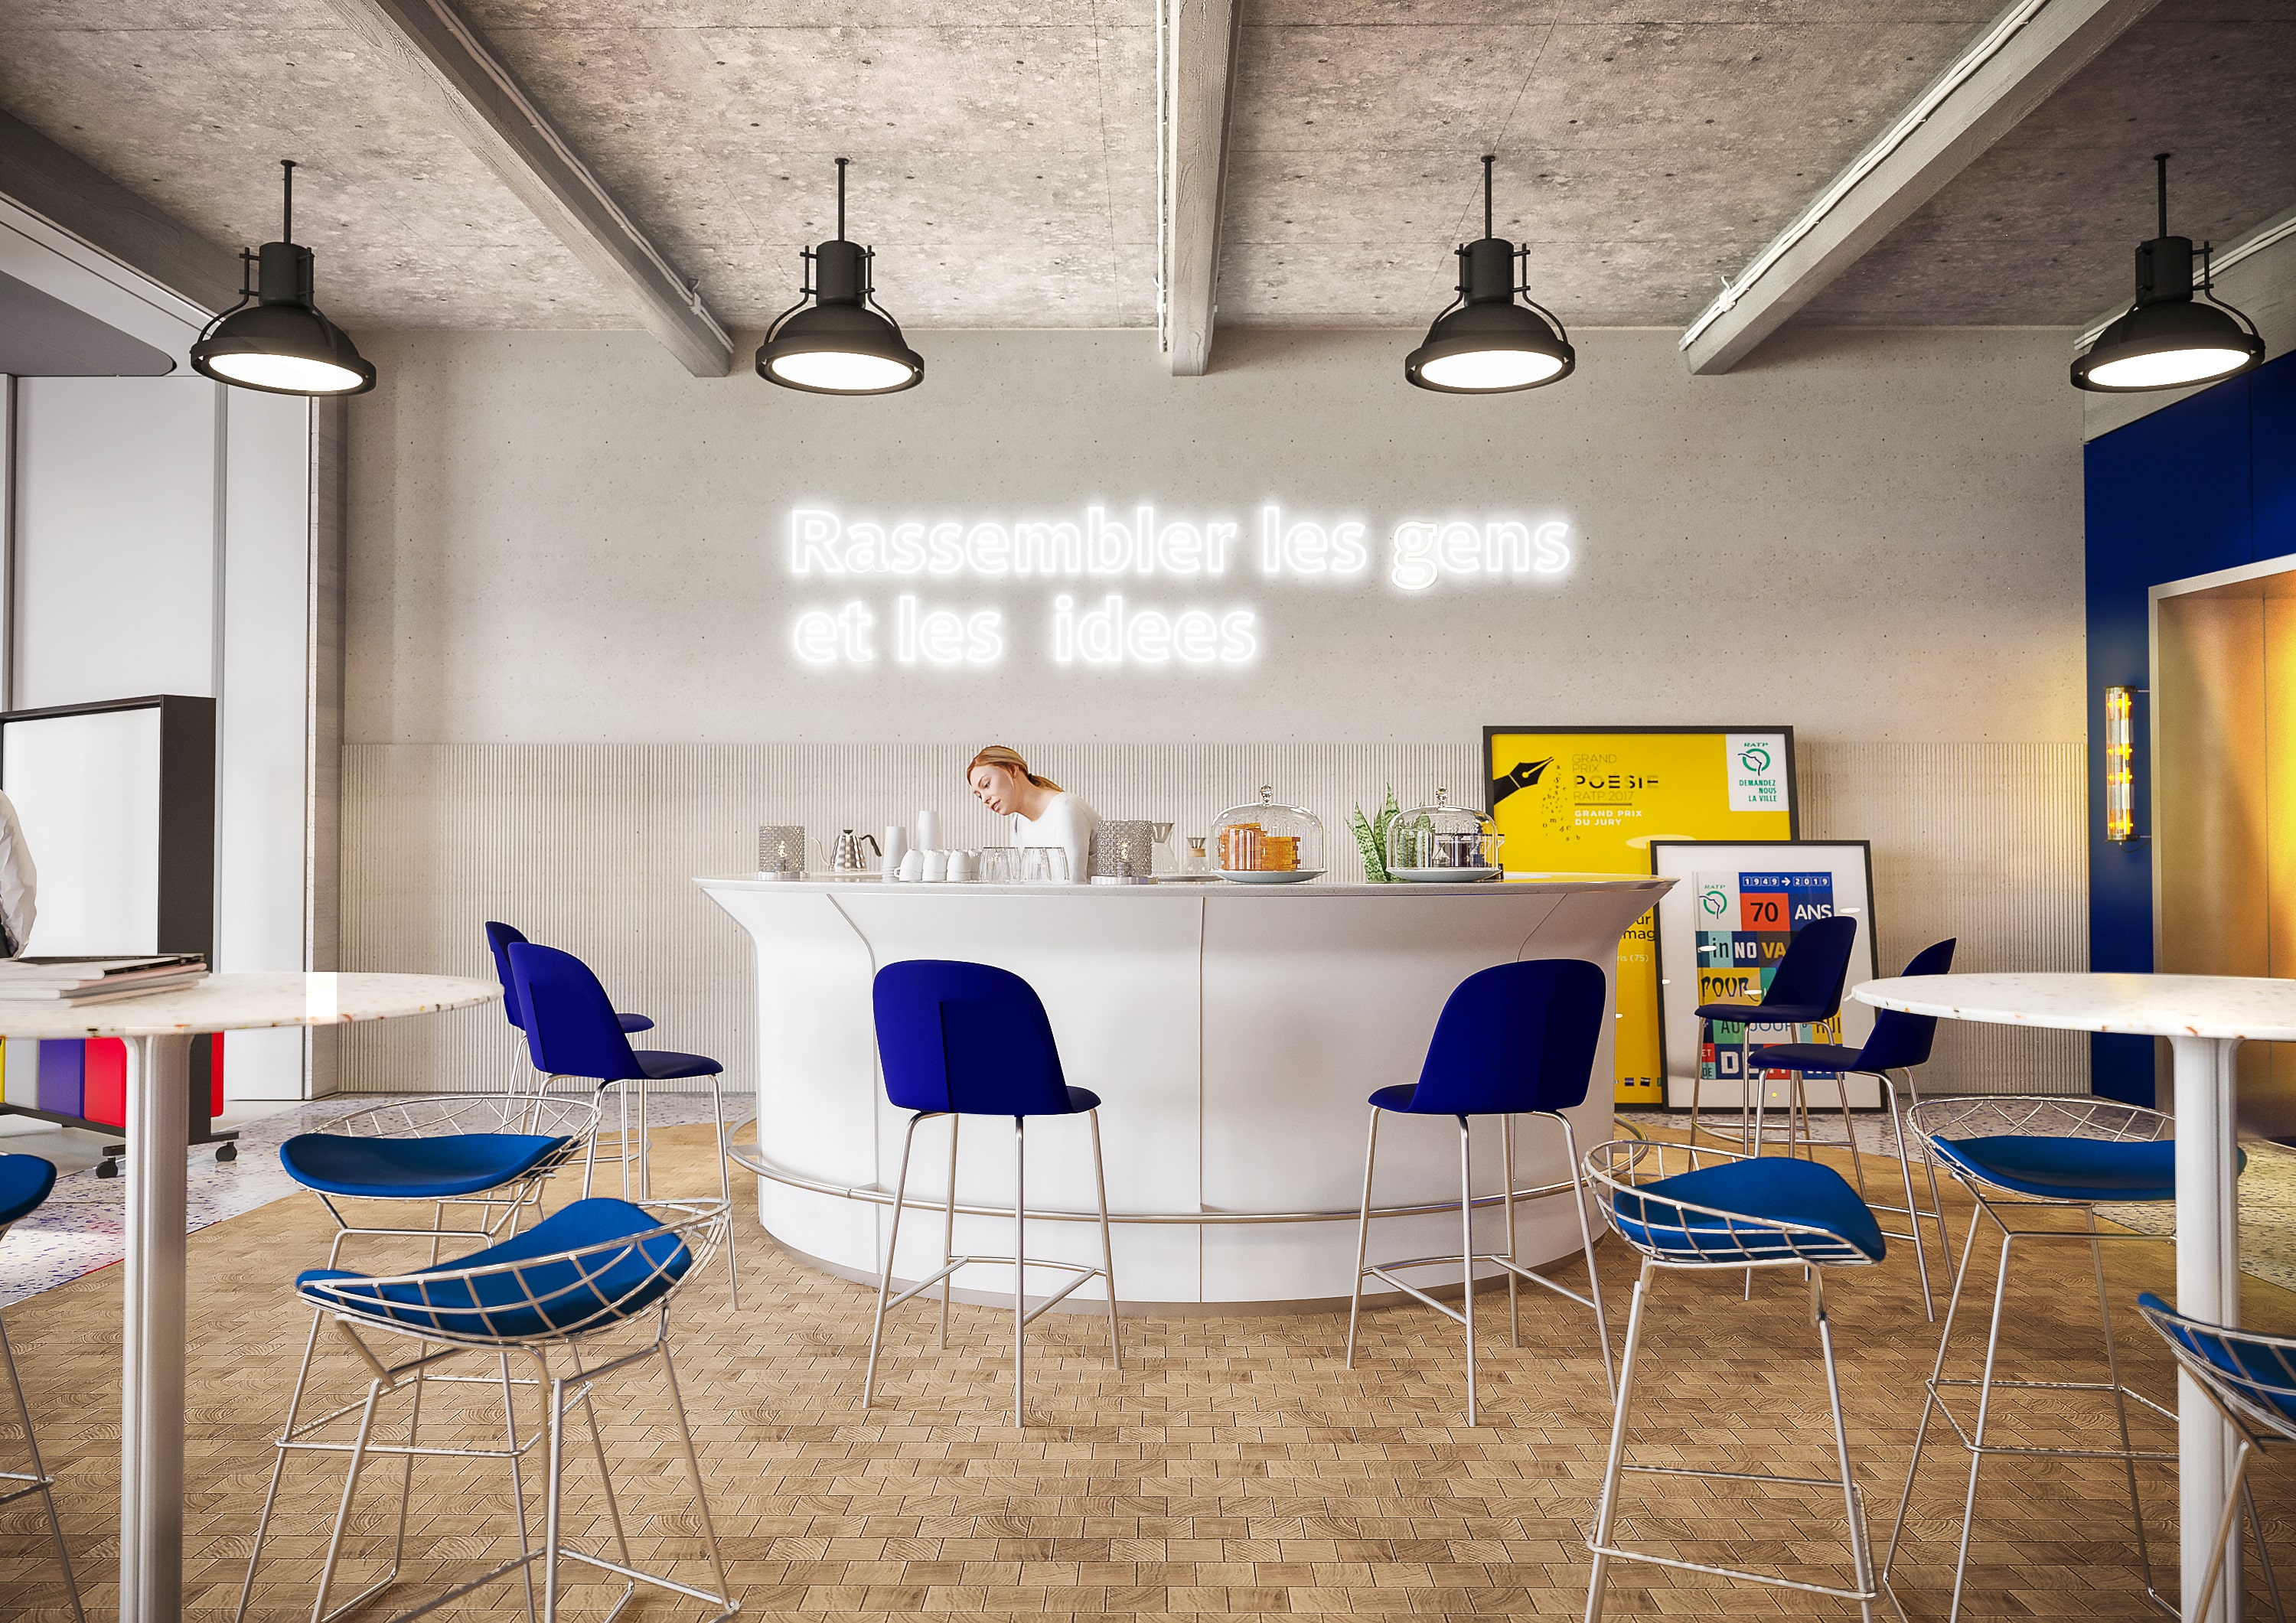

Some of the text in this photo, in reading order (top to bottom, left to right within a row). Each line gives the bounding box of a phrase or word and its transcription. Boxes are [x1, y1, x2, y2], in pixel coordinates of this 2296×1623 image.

[791, 506, 1570, 590] Rassembler les gens
[793, 595, 1256, 663] et les idees
[1572, 754, 1617, 764] GRAND
[1573, 764, 1600, 773] PRIX
[1574, 791, 1634, 801] RATP 2017
[1744, 877, 1828, 885] 1949 2019
[1750, 901, 1832, 922] 70 ANS
[1701, 976, 1759, 1002] POUR
